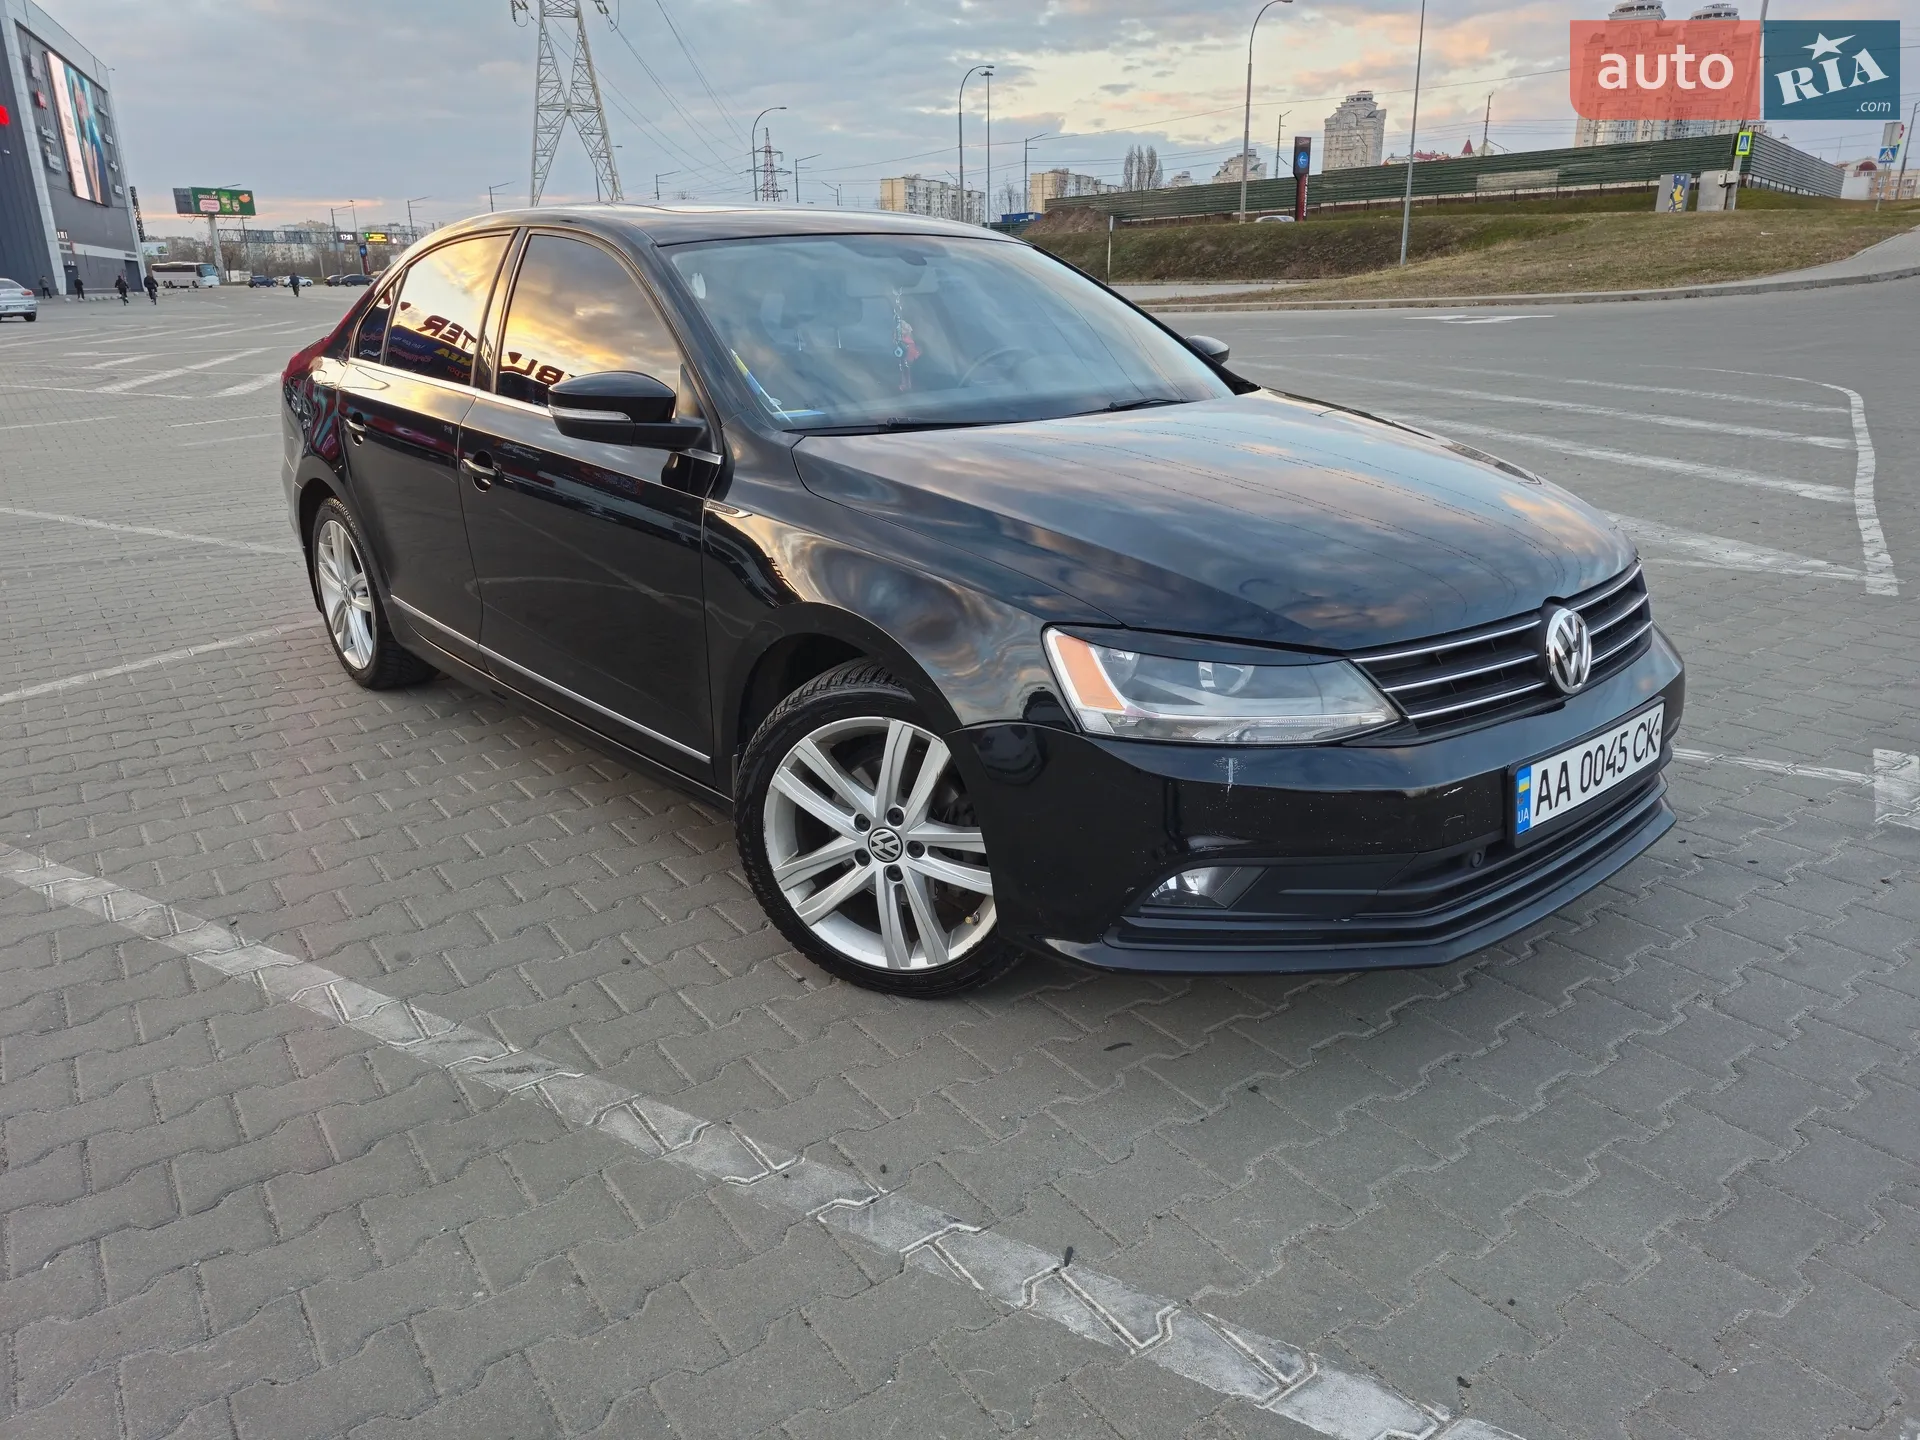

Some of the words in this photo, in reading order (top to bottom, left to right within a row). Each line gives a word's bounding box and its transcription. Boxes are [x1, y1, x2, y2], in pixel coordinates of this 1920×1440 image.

[1535, 760, 1571, 817] AA
[1580, 730, 1629, 794] 0045
[1633, 712, 1661, 763] CK
[1518, 808, 1530, 824] UA
